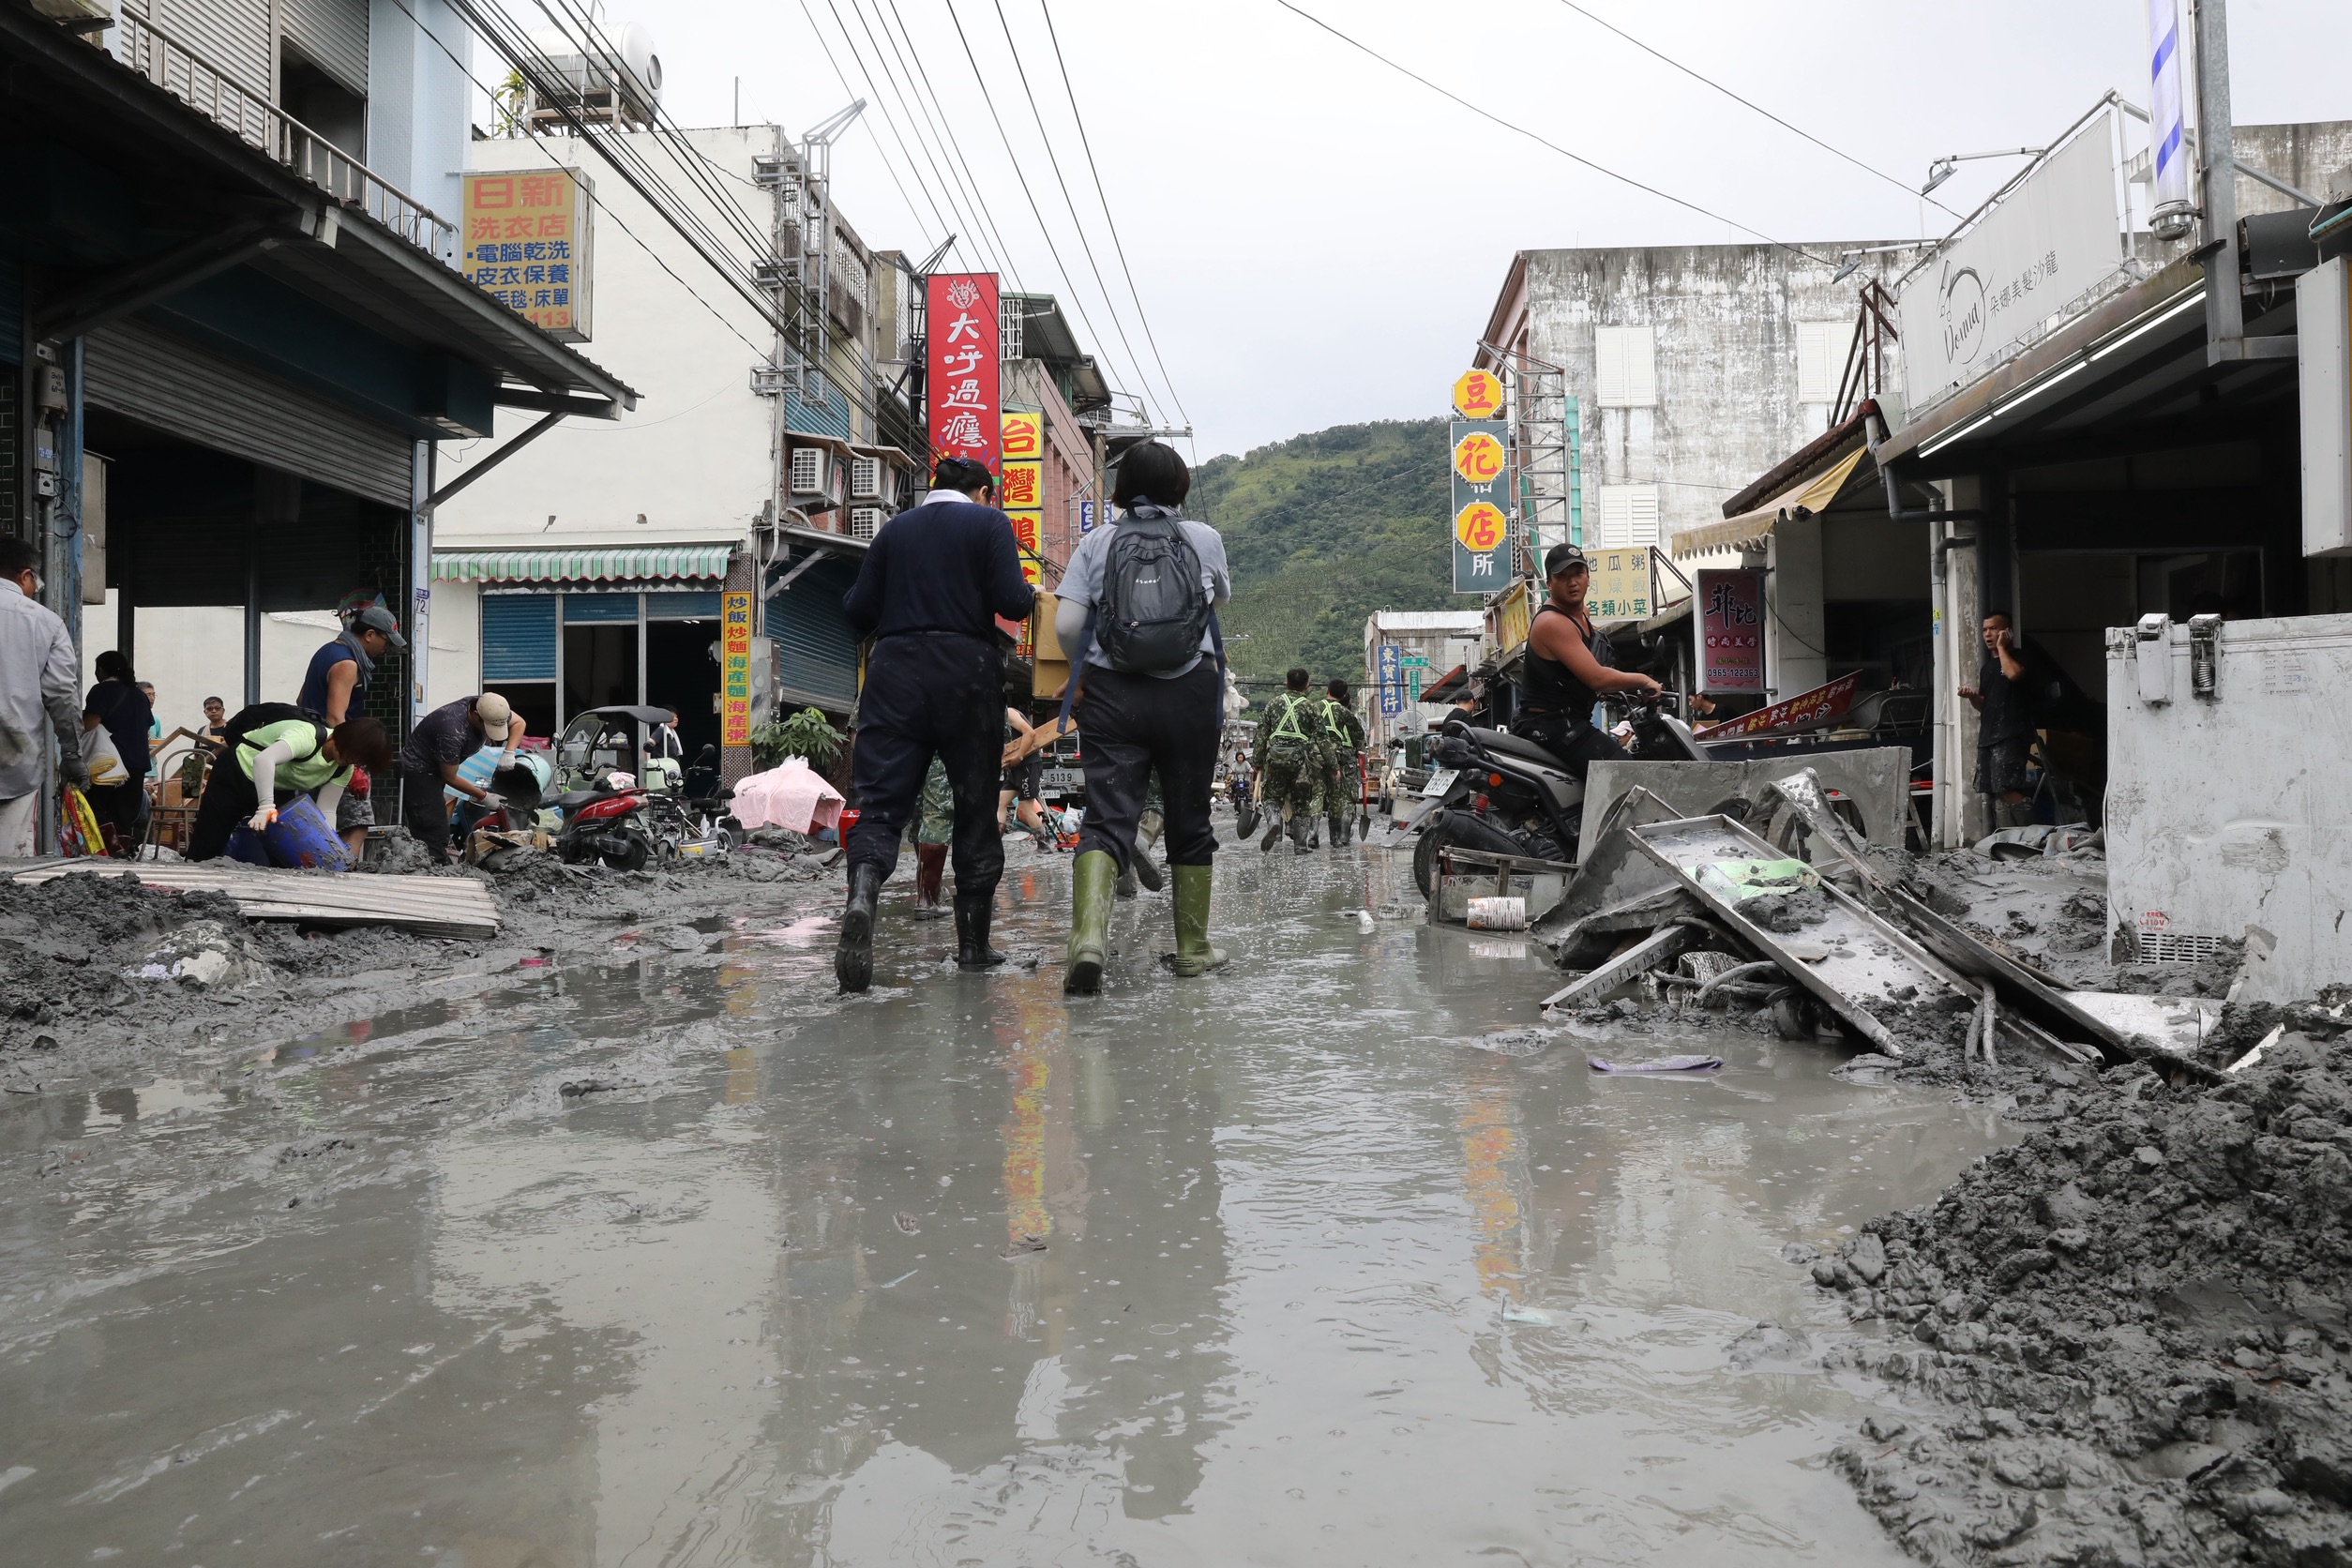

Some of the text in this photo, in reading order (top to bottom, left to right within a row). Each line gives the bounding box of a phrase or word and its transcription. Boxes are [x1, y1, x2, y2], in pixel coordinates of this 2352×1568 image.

[474, 175, 565, 209] 日新
[471, 214, 567, 240] 洗衣店
[476, 241, 570, 264] 電腦乾洗
[476, 264, 569, 286] 皮衣保養
[1990, 250, 2058, 319] 朵娜美髮沙龍
[941, 312, 988, 448] 大呼過癮
[1459, 374, 1499, 547] 豆花店
[1587, 598, 1648, 617] 各類小菜
[1705, 583, 1758, 630] 菲比
[1381, 647, 1399, 712] 東寶商行
[1050, 773, 1072, 782] 5139
